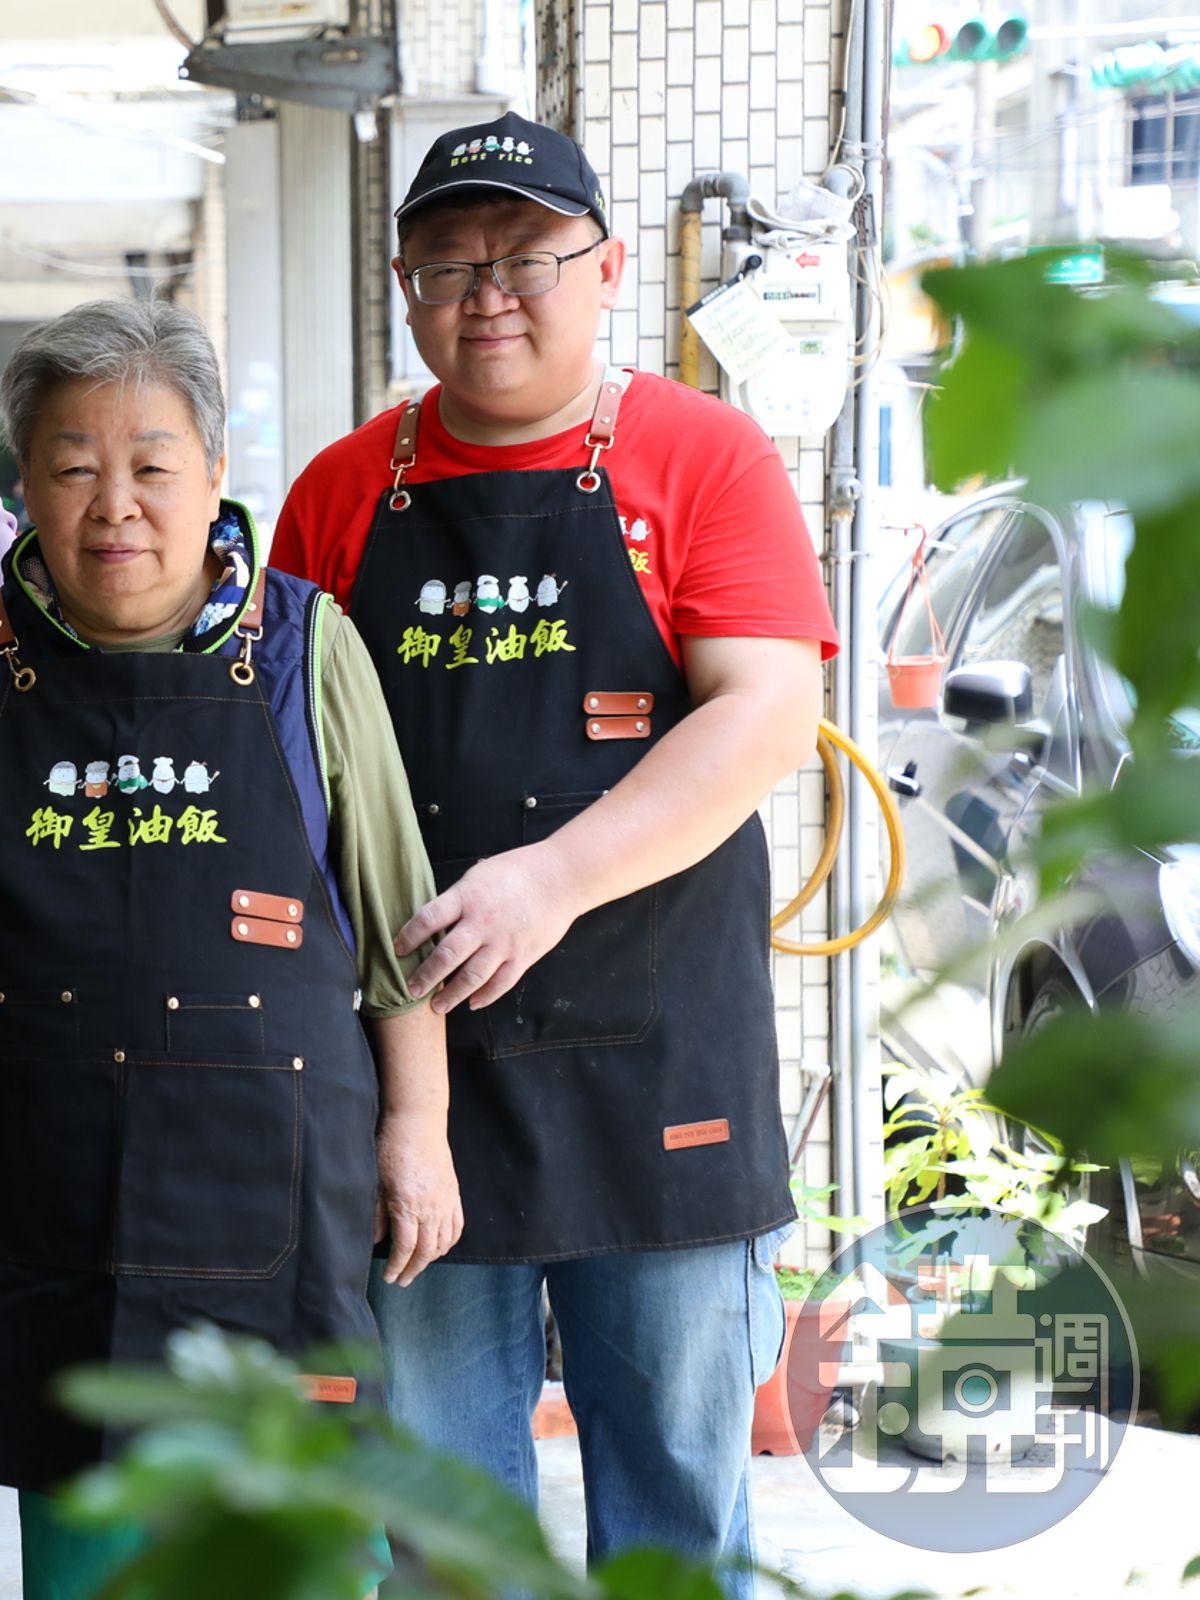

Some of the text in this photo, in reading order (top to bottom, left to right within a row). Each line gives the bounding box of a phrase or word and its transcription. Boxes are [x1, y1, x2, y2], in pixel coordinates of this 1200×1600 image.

[450, 152, 533, 168] Best rice
[397, 618, 577, 670] 御皇油飯
[25, 804, 228, 851] 御皇油飯
